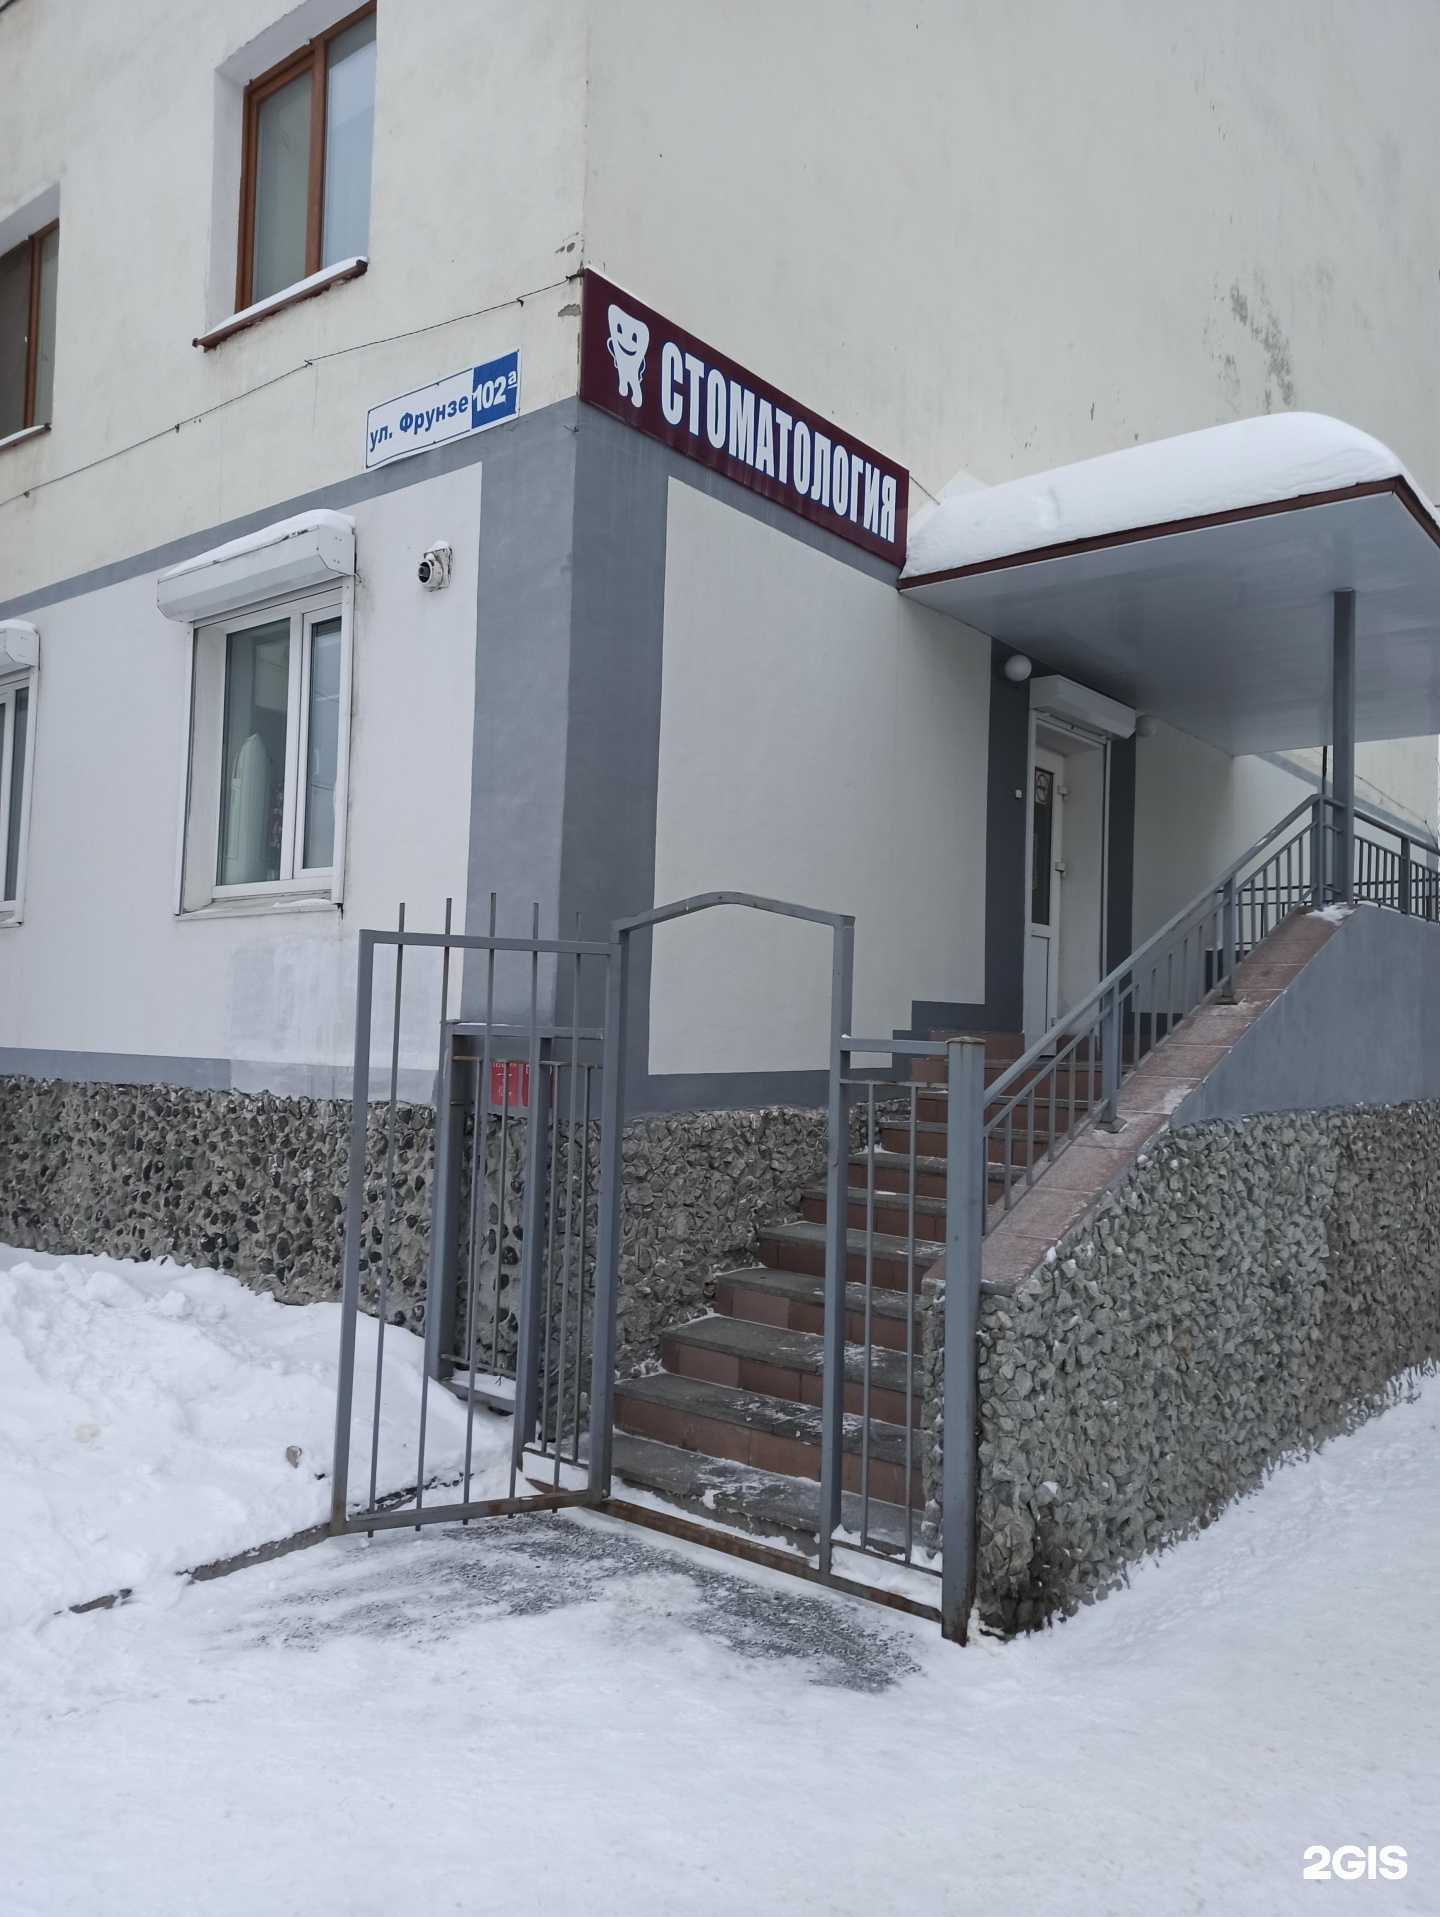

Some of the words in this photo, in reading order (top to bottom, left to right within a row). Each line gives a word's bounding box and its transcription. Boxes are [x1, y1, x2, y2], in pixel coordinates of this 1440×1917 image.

[369, 424, 393, 452] ул.
[399, 395, 469, 435] Фрунзе
[661, 341, 897, 544] СТОМАТОЛОГИЯ
